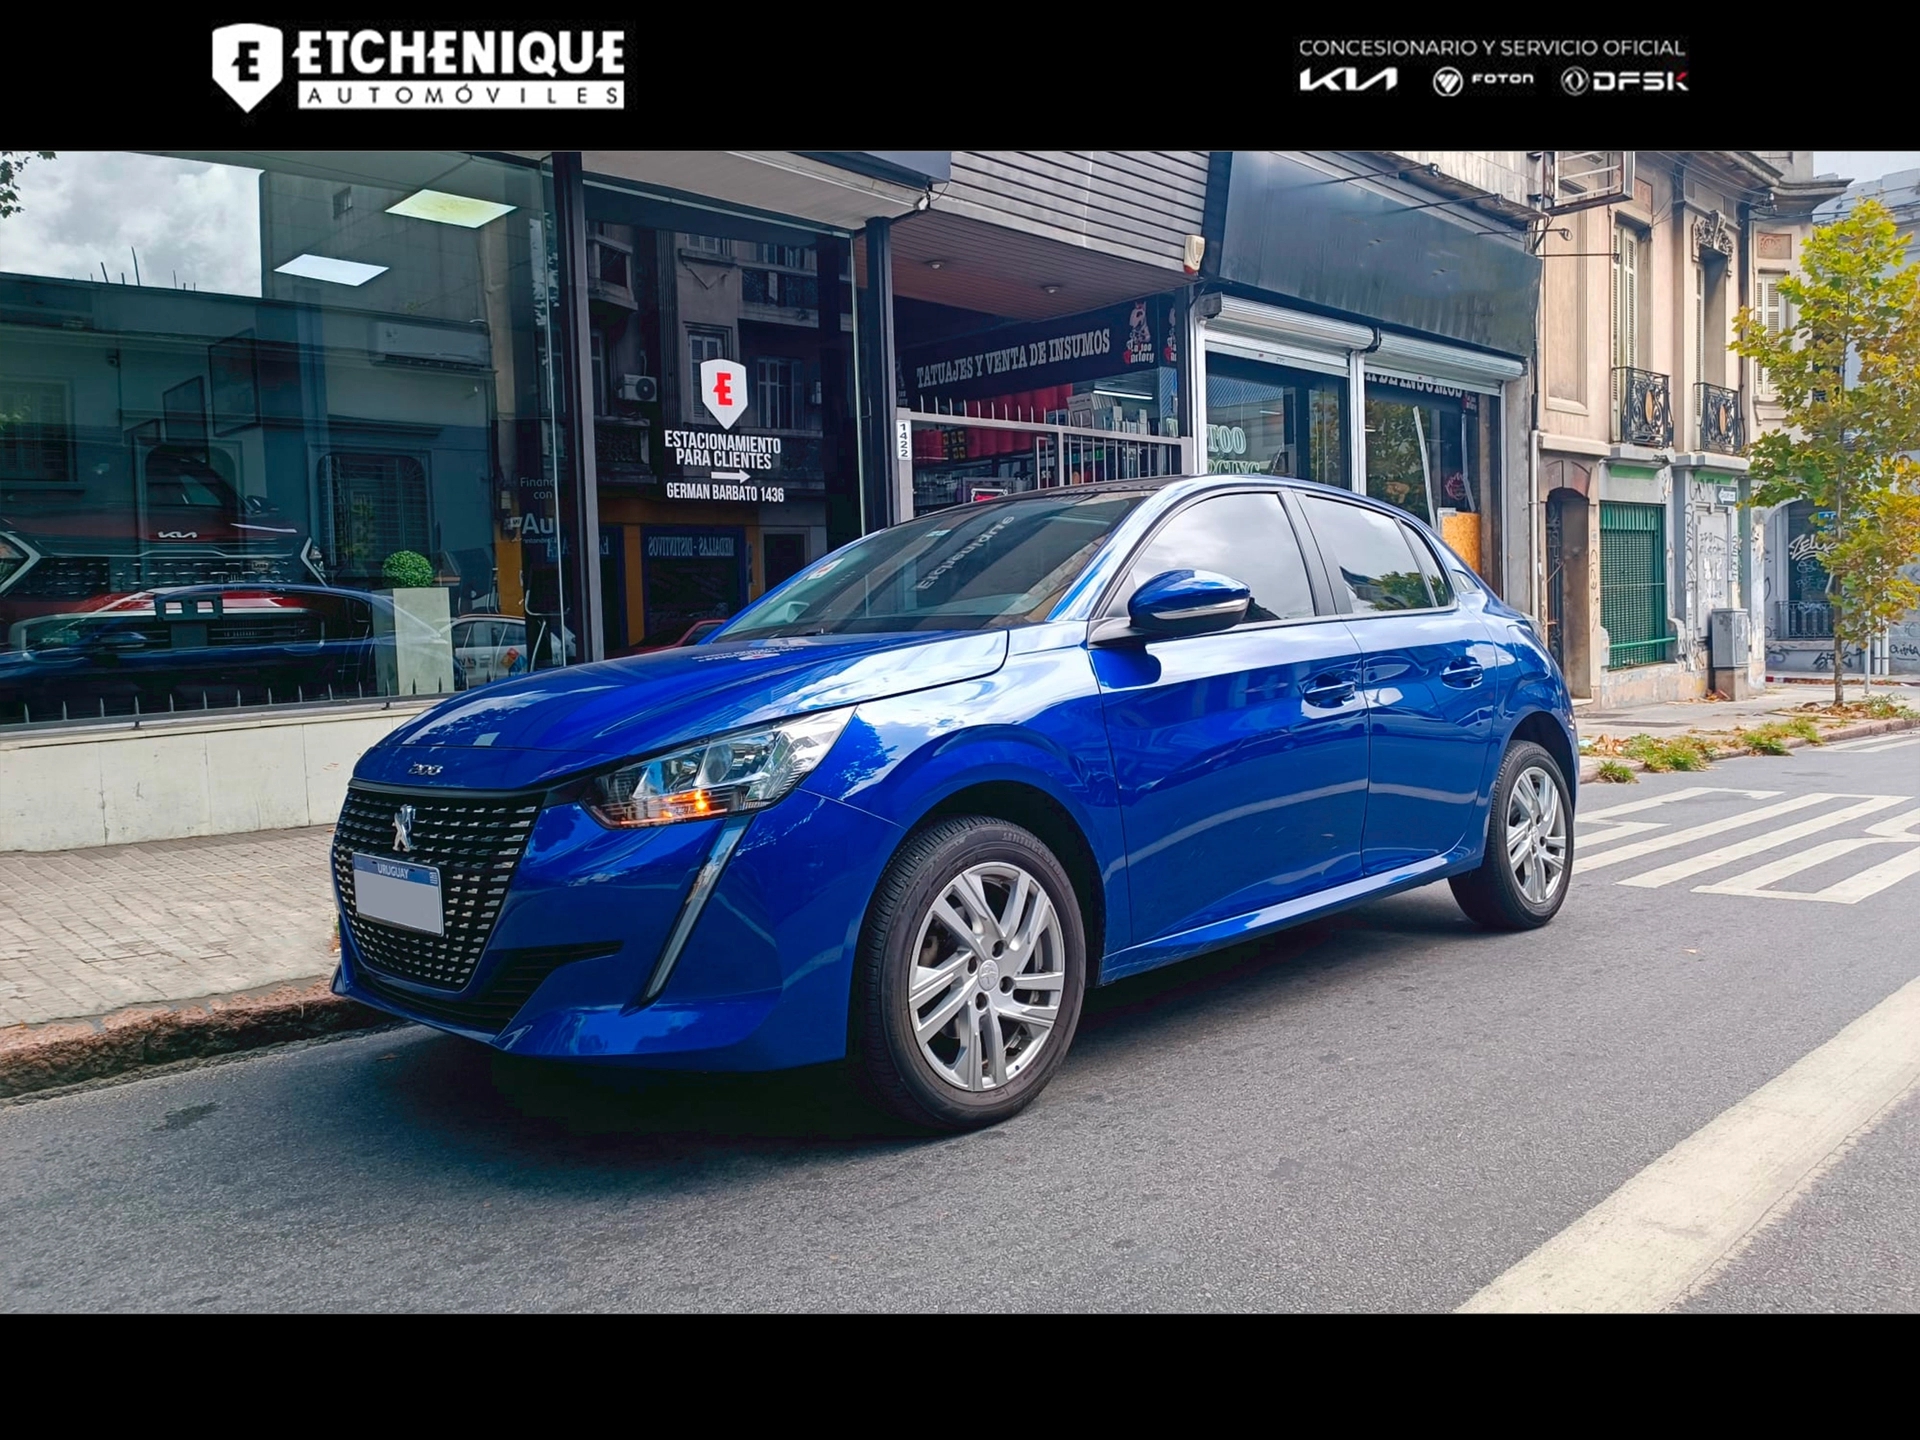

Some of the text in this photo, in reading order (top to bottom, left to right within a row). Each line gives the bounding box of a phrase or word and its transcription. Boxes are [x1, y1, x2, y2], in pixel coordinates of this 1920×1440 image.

[916, 328, 1110, 388] TATUAJES Y VENTA DE INSUMOS
[664, 429, 781, 454] ESTACIONAMIENTO
[899, 423, 909, 456] 1422
[676, 448, 772, 470] PARA CLIENTES
[666, 482, 785, 503] GERMAN BARBATO 1436
[377, 863, 409, 880] URUGUAY
